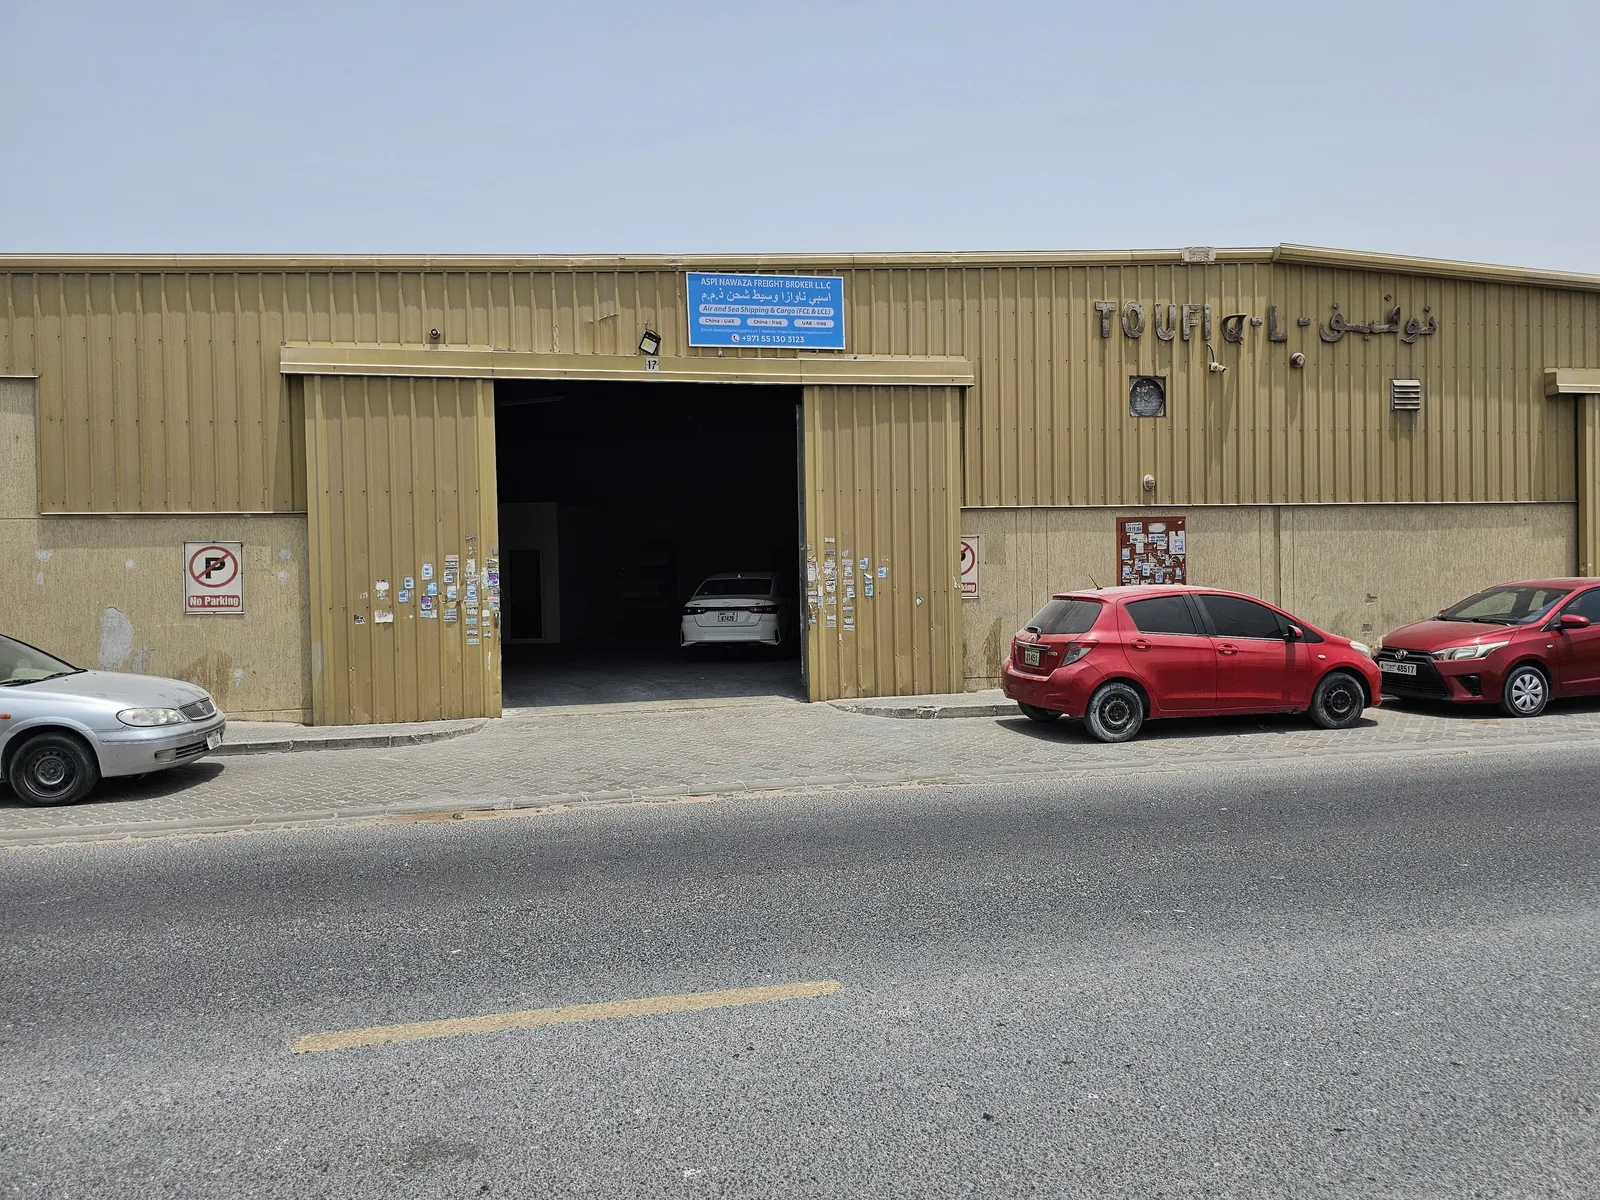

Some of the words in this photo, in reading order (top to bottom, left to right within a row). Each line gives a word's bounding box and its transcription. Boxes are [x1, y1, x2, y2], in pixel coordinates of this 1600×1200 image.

[701, 277, 718, 286] ASPI
[719, 278, 753, 287] NAWAZA
[754, 279, 784, 288] FREIGHT
[785, 280, 814, 289] BROKER
[815, 281, 831, 290] L.L.C
[727, 305, 740, 313] Sea
[740, 306, 770, 314] Shipping
[769, 306, 776, 314] &
[776, 307, 796, 315] Cargo
[796, 307, 810, 315] (FCL
[817, 308, 831, 316] LCL)
[742, 334, 760, 342] +971
[772, 335, 786, 343] 130
[787, 335, 805, 343] 3123
[189, 596, 202, 606] No
[204, 596, 239, 607] Parking
[1396, 664, 1415, 674] 48517
